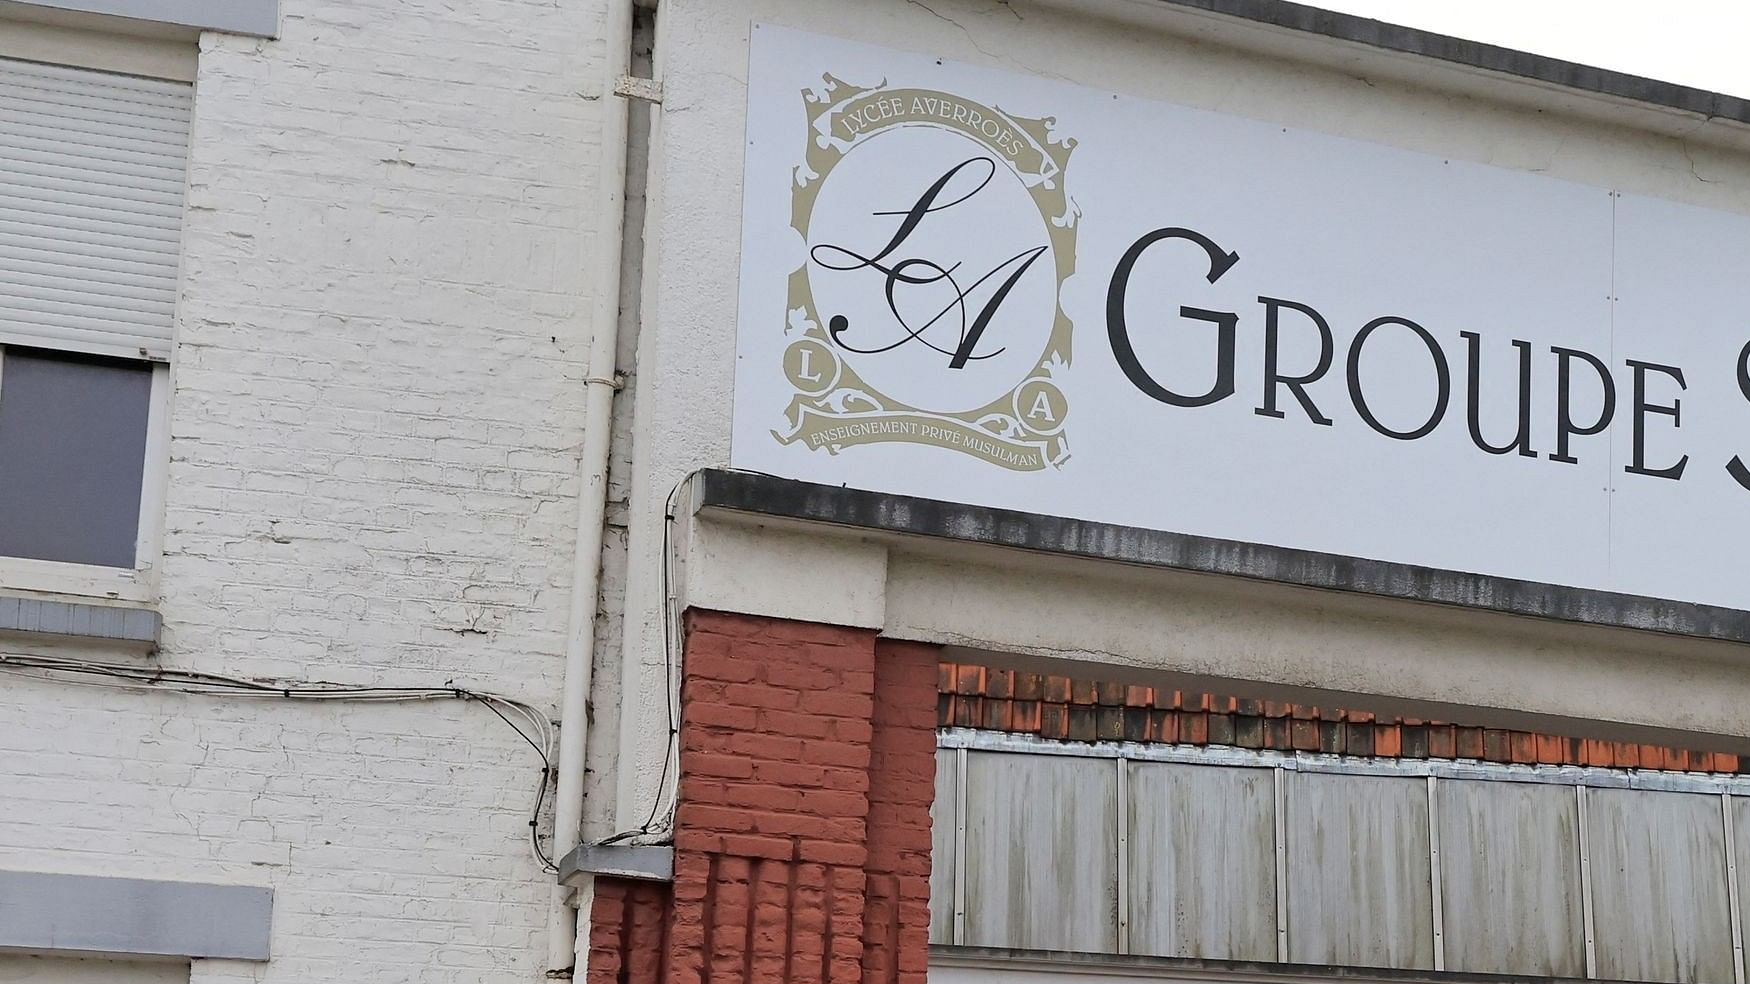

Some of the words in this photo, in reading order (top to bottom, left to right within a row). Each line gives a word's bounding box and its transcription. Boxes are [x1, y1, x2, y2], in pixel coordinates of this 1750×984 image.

[840, 96, 905, 135] LYCÉE
[910, 97, 1025, 157] AVERROÈS
[1106, 228, 1688, 480] GROUPE
[811, 421, 918, 446] ENSEIGNEMENT
[921, 422, 961, 445] PRIVÉ
[963, 434, 1038, 466] MUSULMAN
